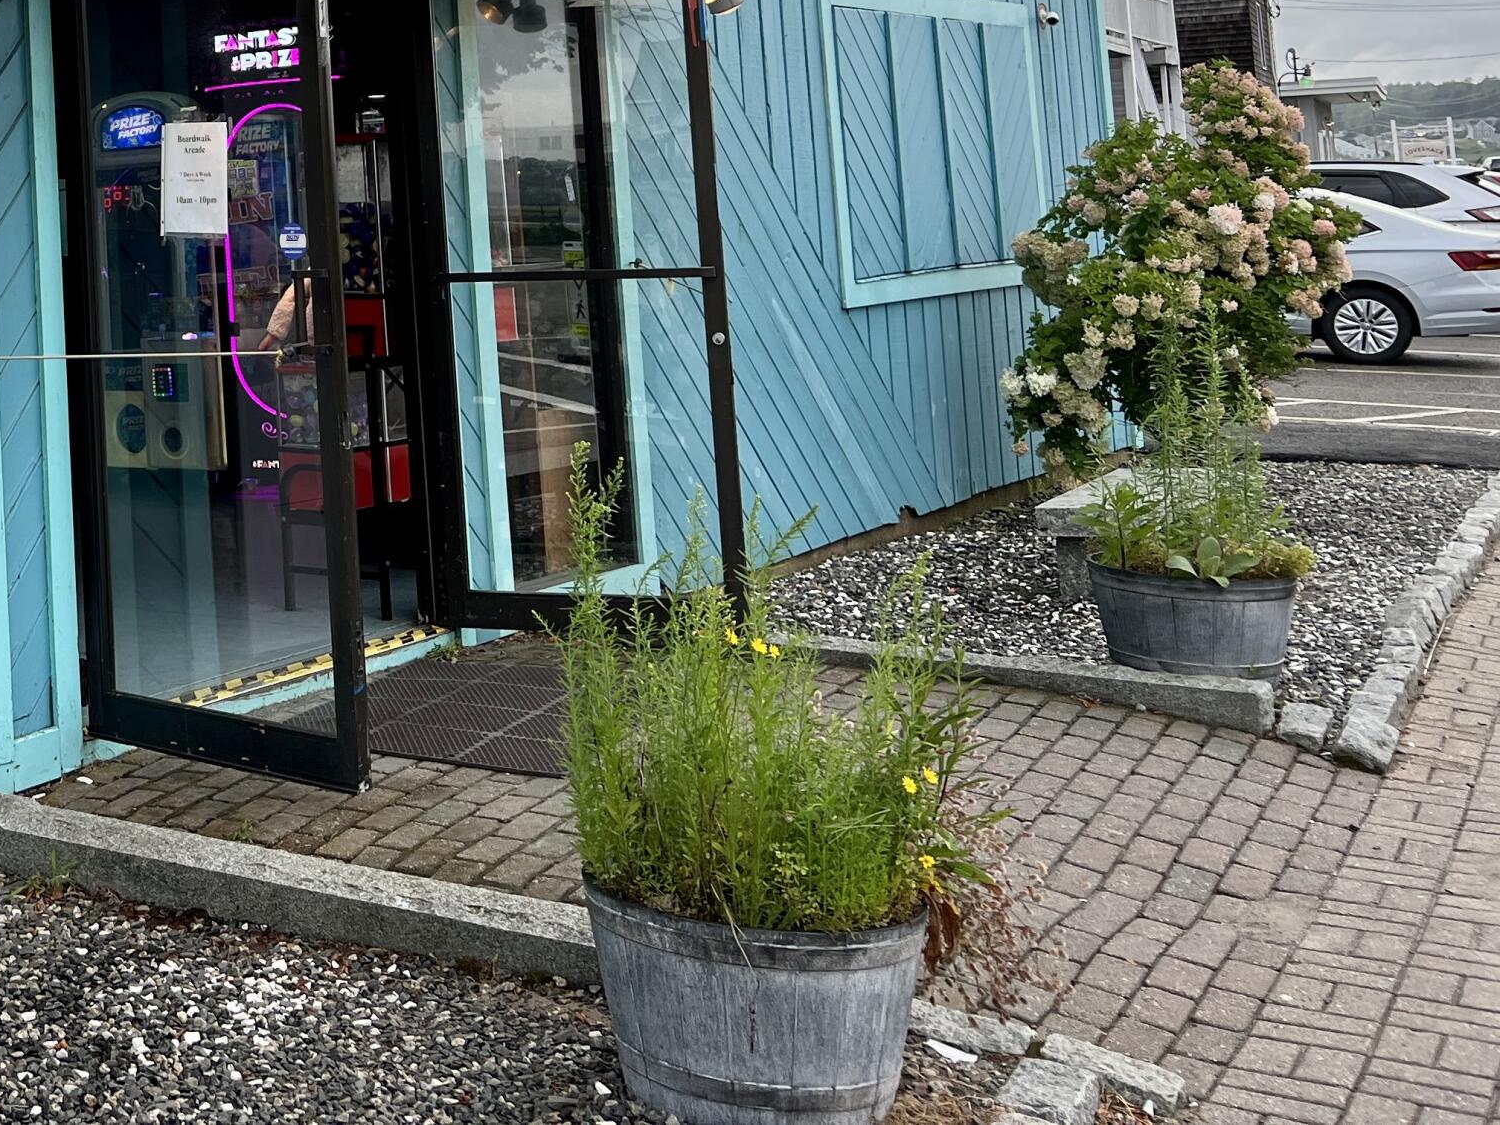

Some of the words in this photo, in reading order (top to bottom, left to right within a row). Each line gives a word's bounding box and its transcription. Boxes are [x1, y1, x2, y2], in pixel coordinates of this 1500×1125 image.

[110, 113, 150, 132] PRIZE
[118, 124, 158, 139] FACTORY
[177, 134, 212, 144] Boardwalk
[236, 124, 272, 141] RIZE
[184, 146, 206, 154] Arcade
[235, 140, 280, 156] FACTORY
[176, 195, 193, 204] 10am
[199, 195, 218, 206] 10pm
[228, 191, 275, 225] IN
